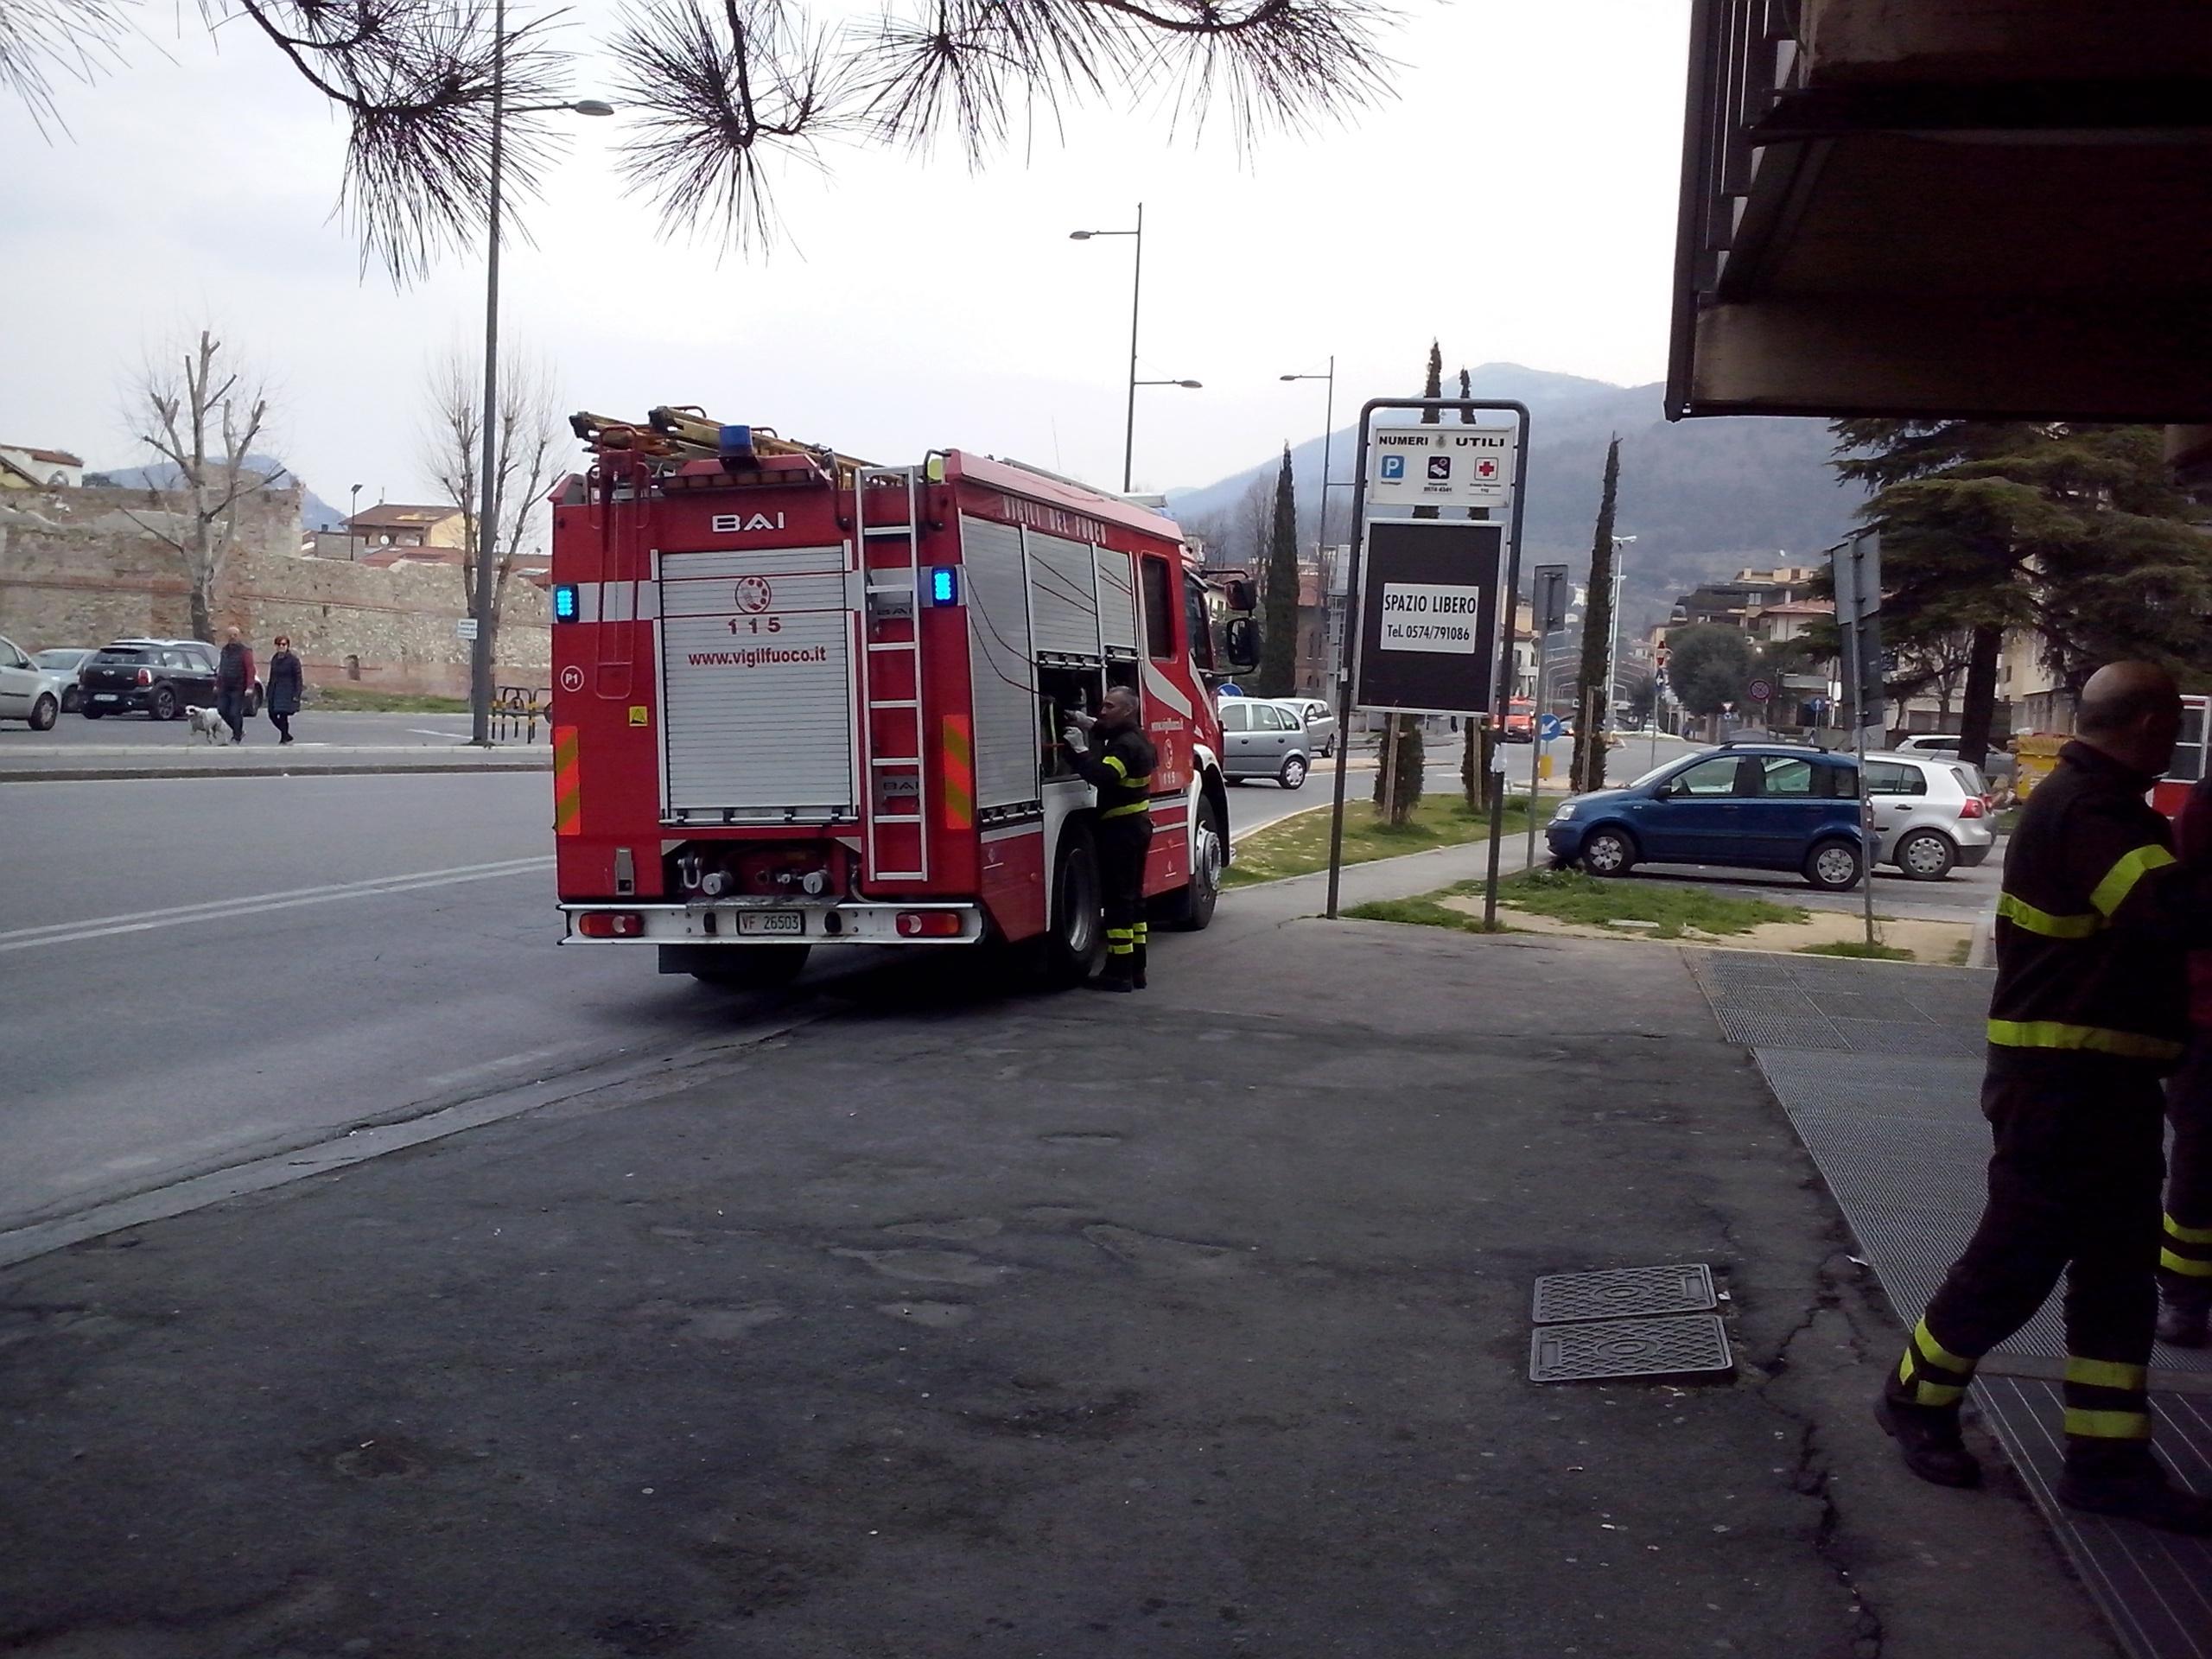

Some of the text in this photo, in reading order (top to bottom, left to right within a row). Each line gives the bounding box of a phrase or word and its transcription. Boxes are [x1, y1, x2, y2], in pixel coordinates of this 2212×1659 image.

[1379, 435, 1504, 448] NUMERI UTILI
[1386, 457, 1400, 476] P
[712, 512, 785, 532] BAI
[1075, 515, 1107, 545] FUOCO
[1384, 594, 1477, 613] SPAZIO LIBERO
[1406, 625, 1470, 640] 0574/791086
[688, 645, 827, 668] www.vigilfuoco.it
[565, 673, 578, 684] P1
[883, 781, 919, 791] BAI
[741, 916, 798, 930] VF 26503
